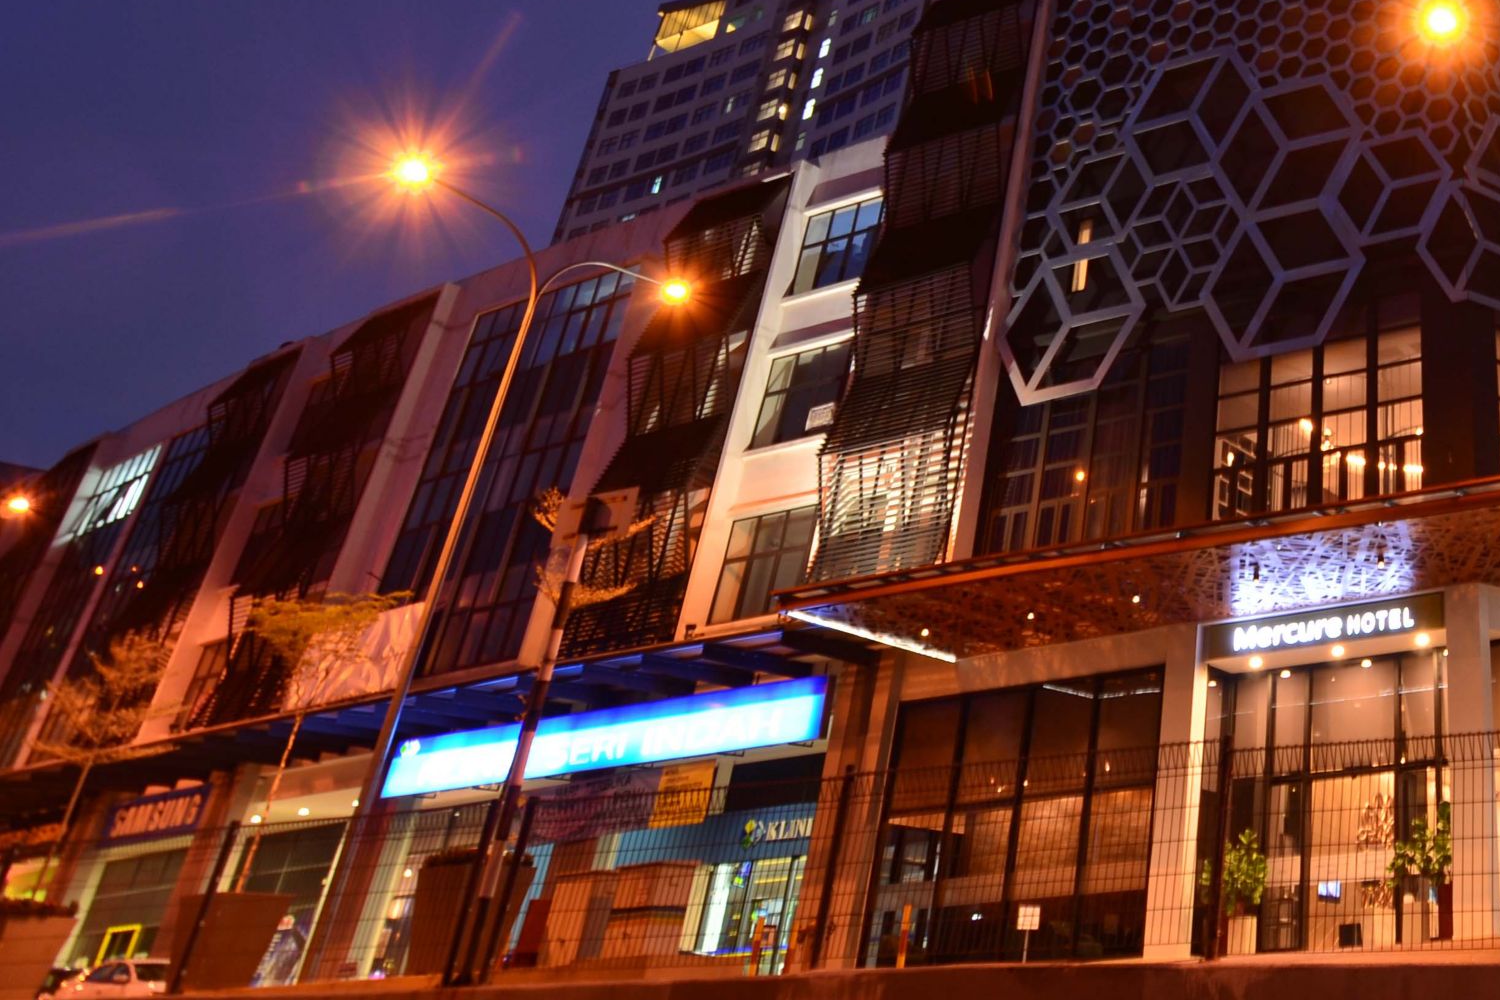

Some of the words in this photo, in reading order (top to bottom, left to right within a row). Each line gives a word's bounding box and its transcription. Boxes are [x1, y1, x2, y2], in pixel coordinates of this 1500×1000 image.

[1233, 615, 1343, 651] Mercure
[1347, 606, 1415, 636] HOTEL
[110, 794, 202, 837] SAMSUNG
[765, 817, 814, 841] KLINI
